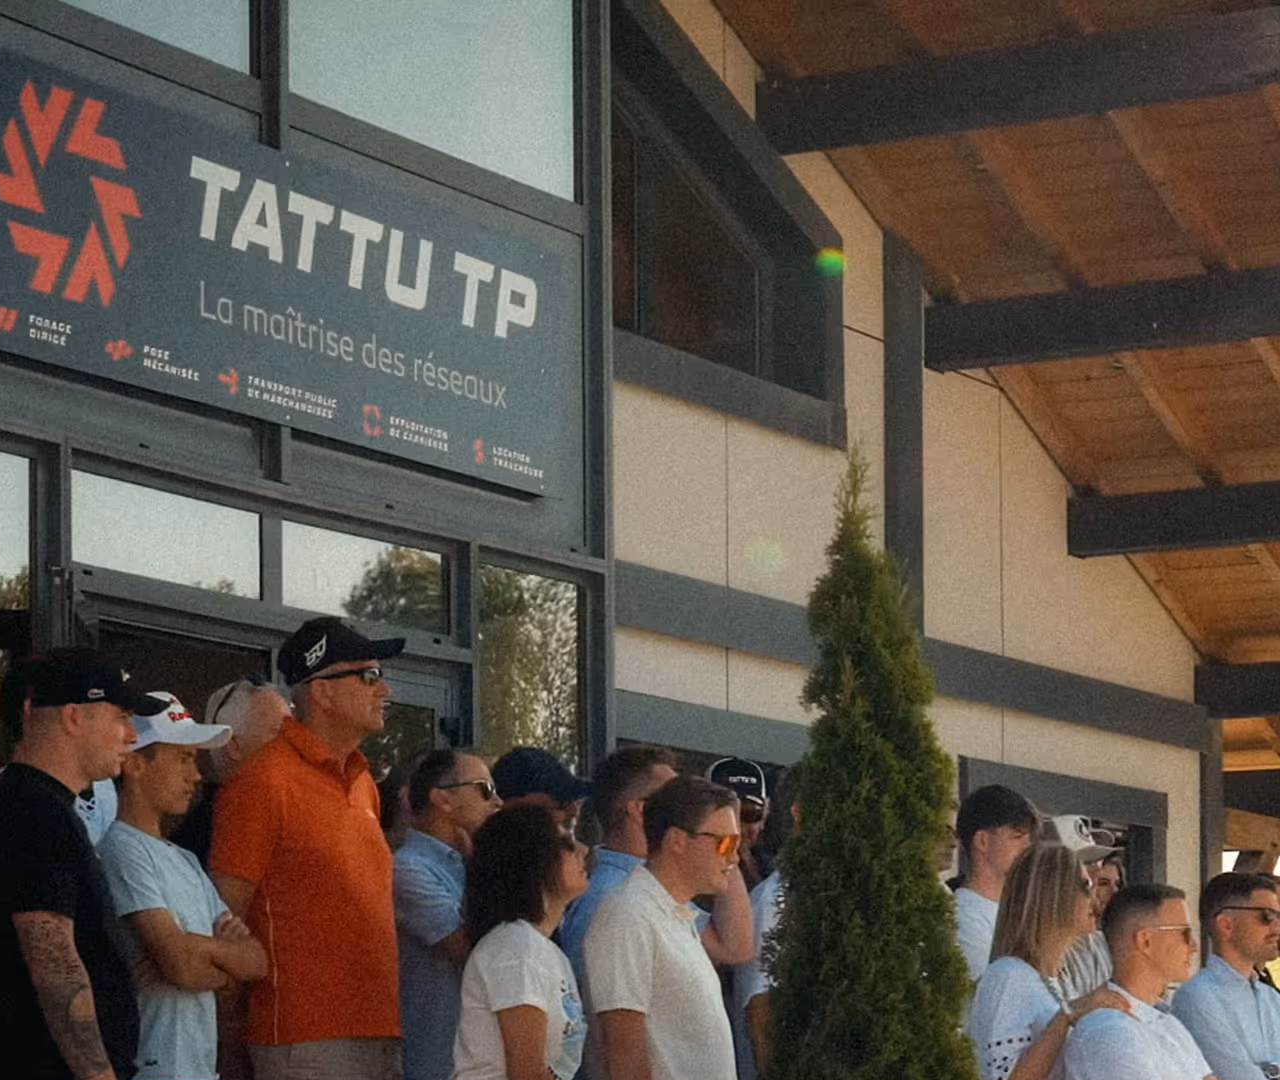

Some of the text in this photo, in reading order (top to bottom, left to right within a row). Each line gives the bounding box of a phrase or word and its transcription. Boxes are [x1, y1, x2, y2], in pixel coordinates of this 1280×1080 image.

[190, 156, 538, 339] TATTU TP
[28, 314, 73, 334] FORAGE
[143, 345, 170, 360] POSE
[200, 280, 508, 409] La maîtrise des réseaux
[247, 388, 334, 419] DE MARCHANDISES
[248, 375, 337, 408] TRANSPORT PUBLIC
[389, 416, 449, 440] EXPLOITATION
